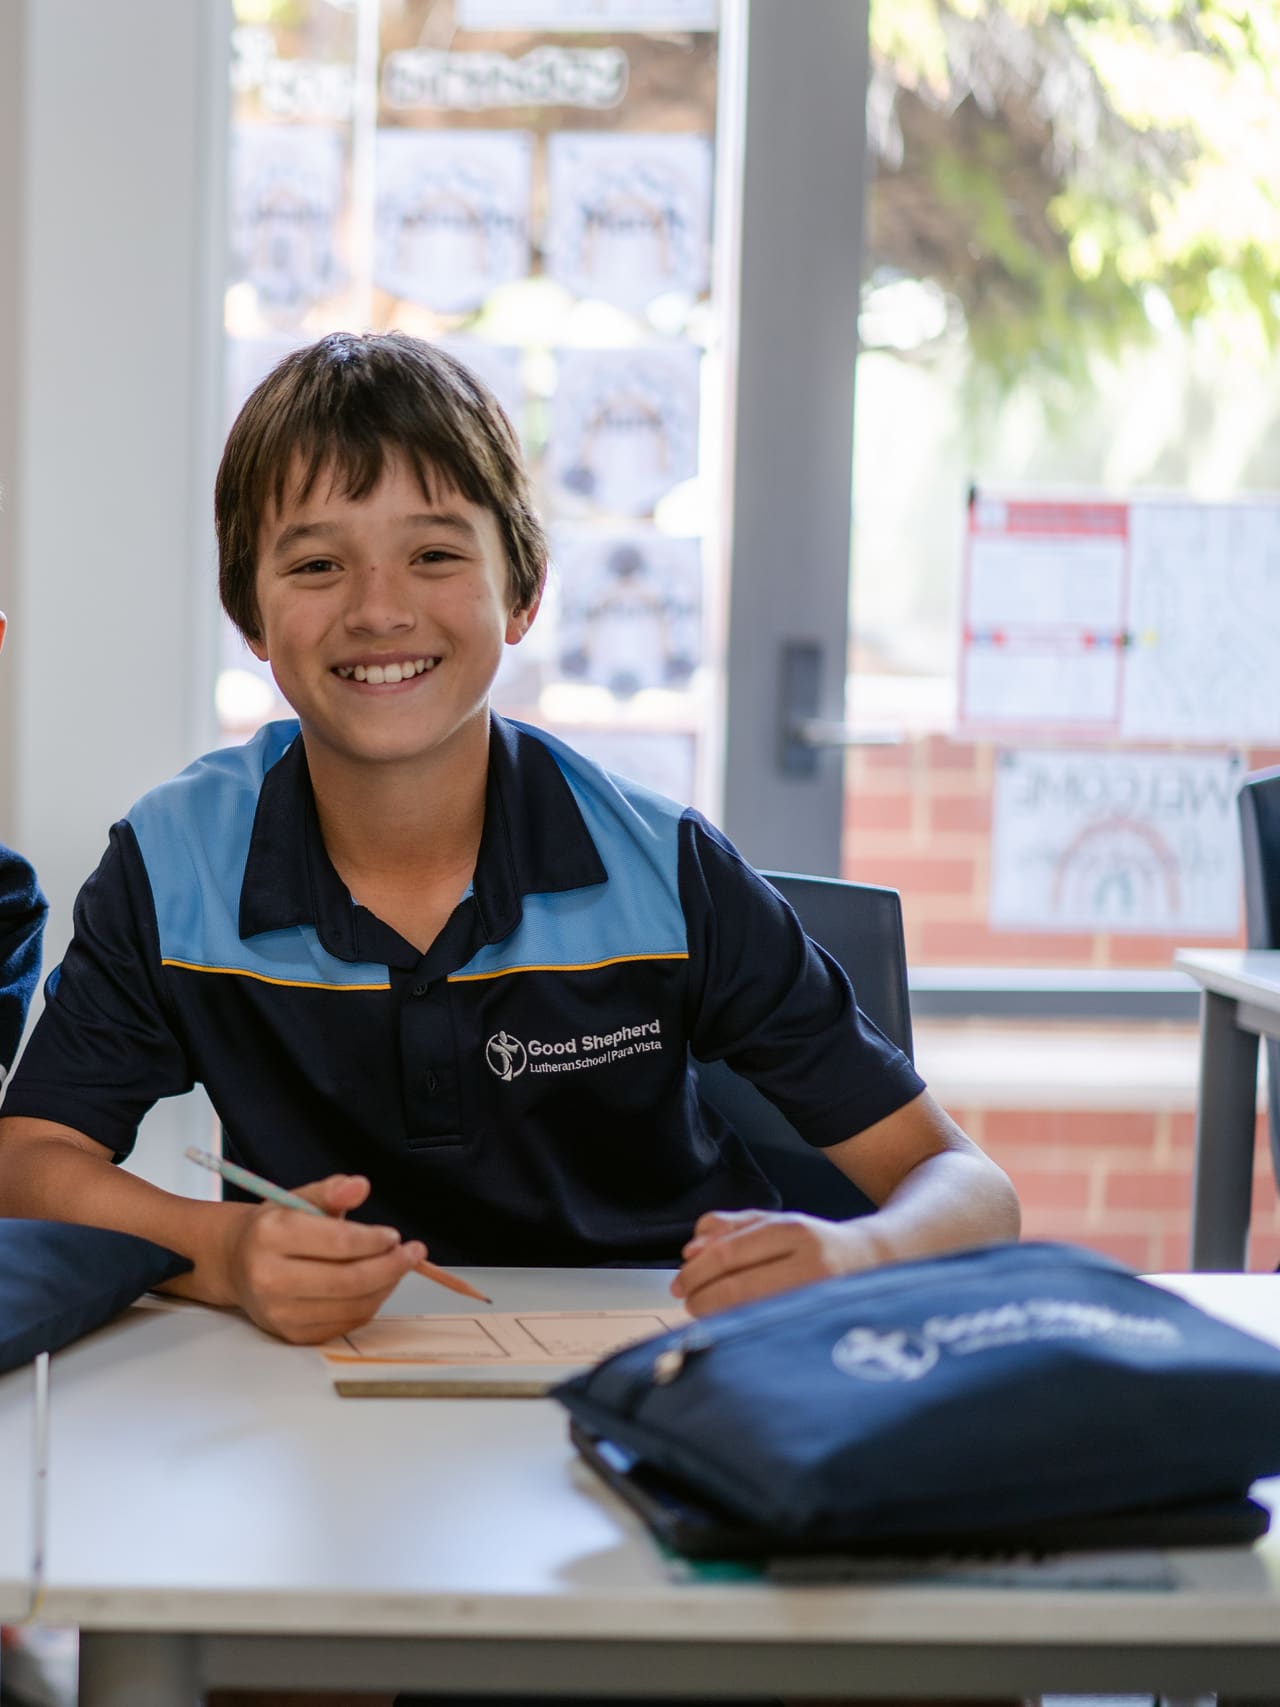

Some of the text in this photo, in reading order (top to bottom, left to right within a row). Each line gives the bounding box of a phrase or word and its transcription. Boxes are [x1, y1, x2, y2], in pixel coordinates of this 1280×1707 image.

[528, 1019, 660, 1056] Good Shepherd
[530, 1041, 662, 1072] Lutheran School Para Vista
